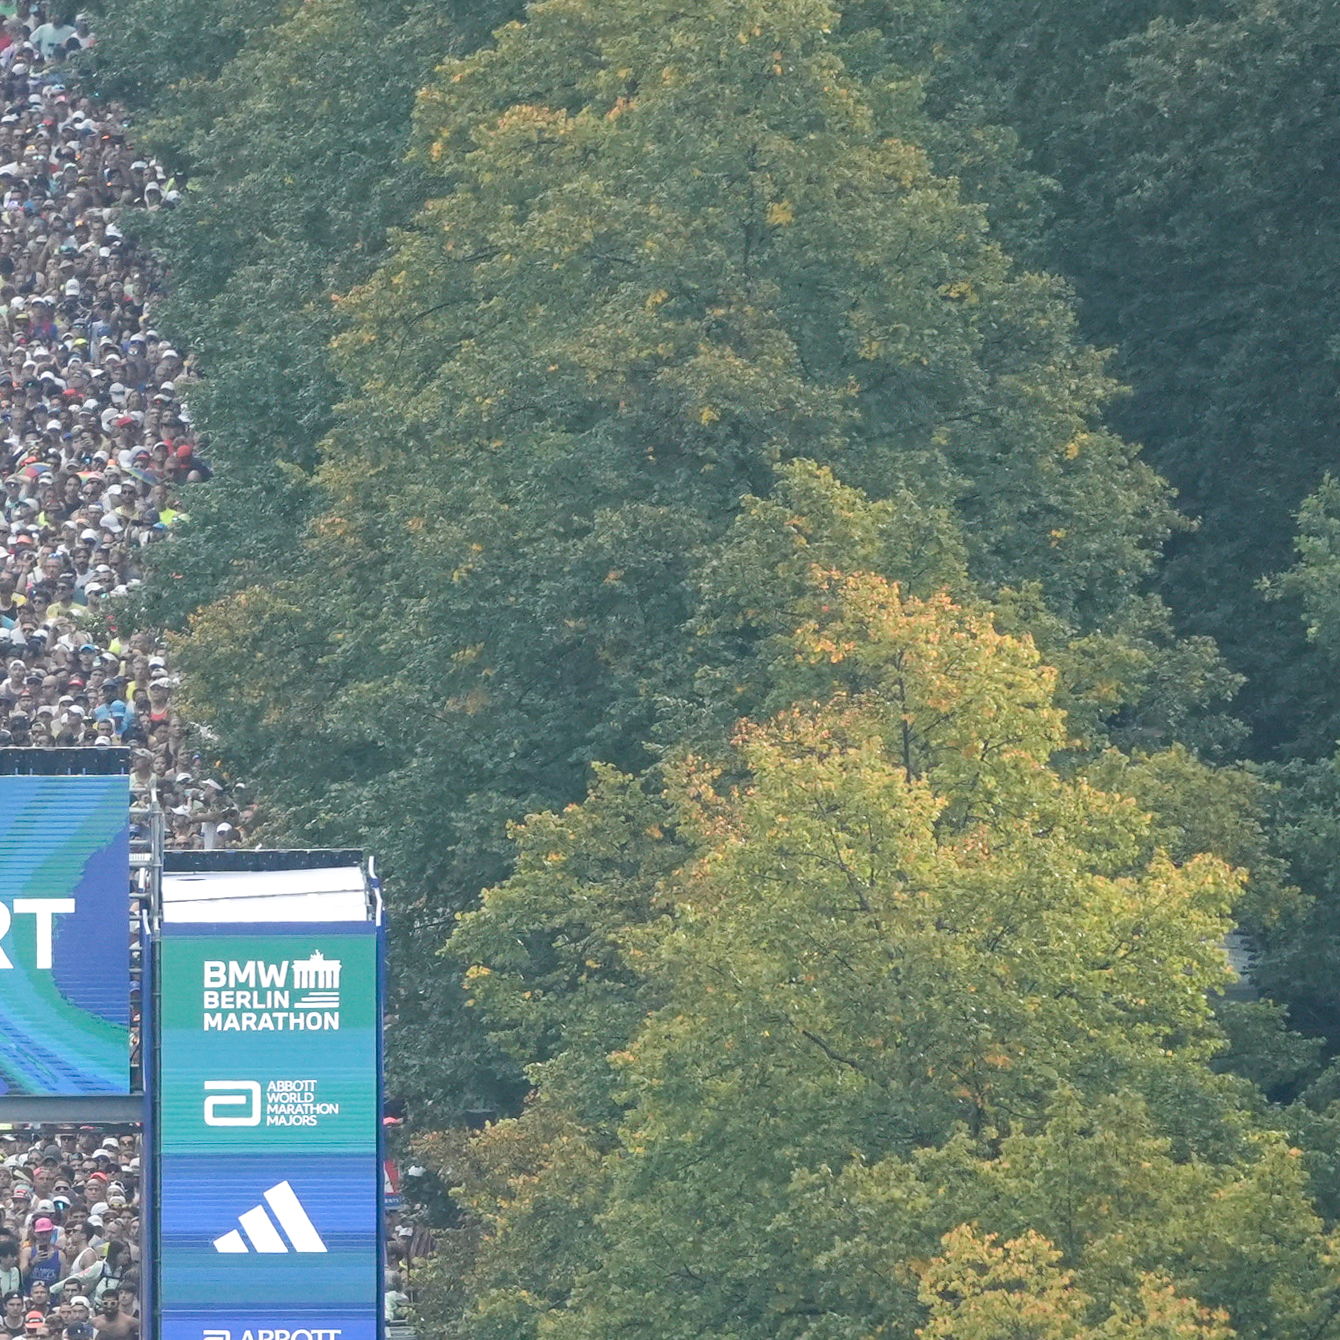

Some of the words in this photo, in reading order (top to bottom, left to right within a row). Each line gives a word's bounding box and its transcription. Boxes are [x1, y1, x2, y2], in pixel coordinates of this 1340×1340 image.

[204, 961, 289, 988] BMW
[204, 991, 290, 1009] BERLIN
[204, 1012, 340, 1031] MARATHON
[267, 1081, 318, 1093] ABBOTT
[267, 1093, 315, 1104] WORLD
[267, 1105, 340, 1116] MARATHON
[267, 1116, 318, 1127] MAJORS
